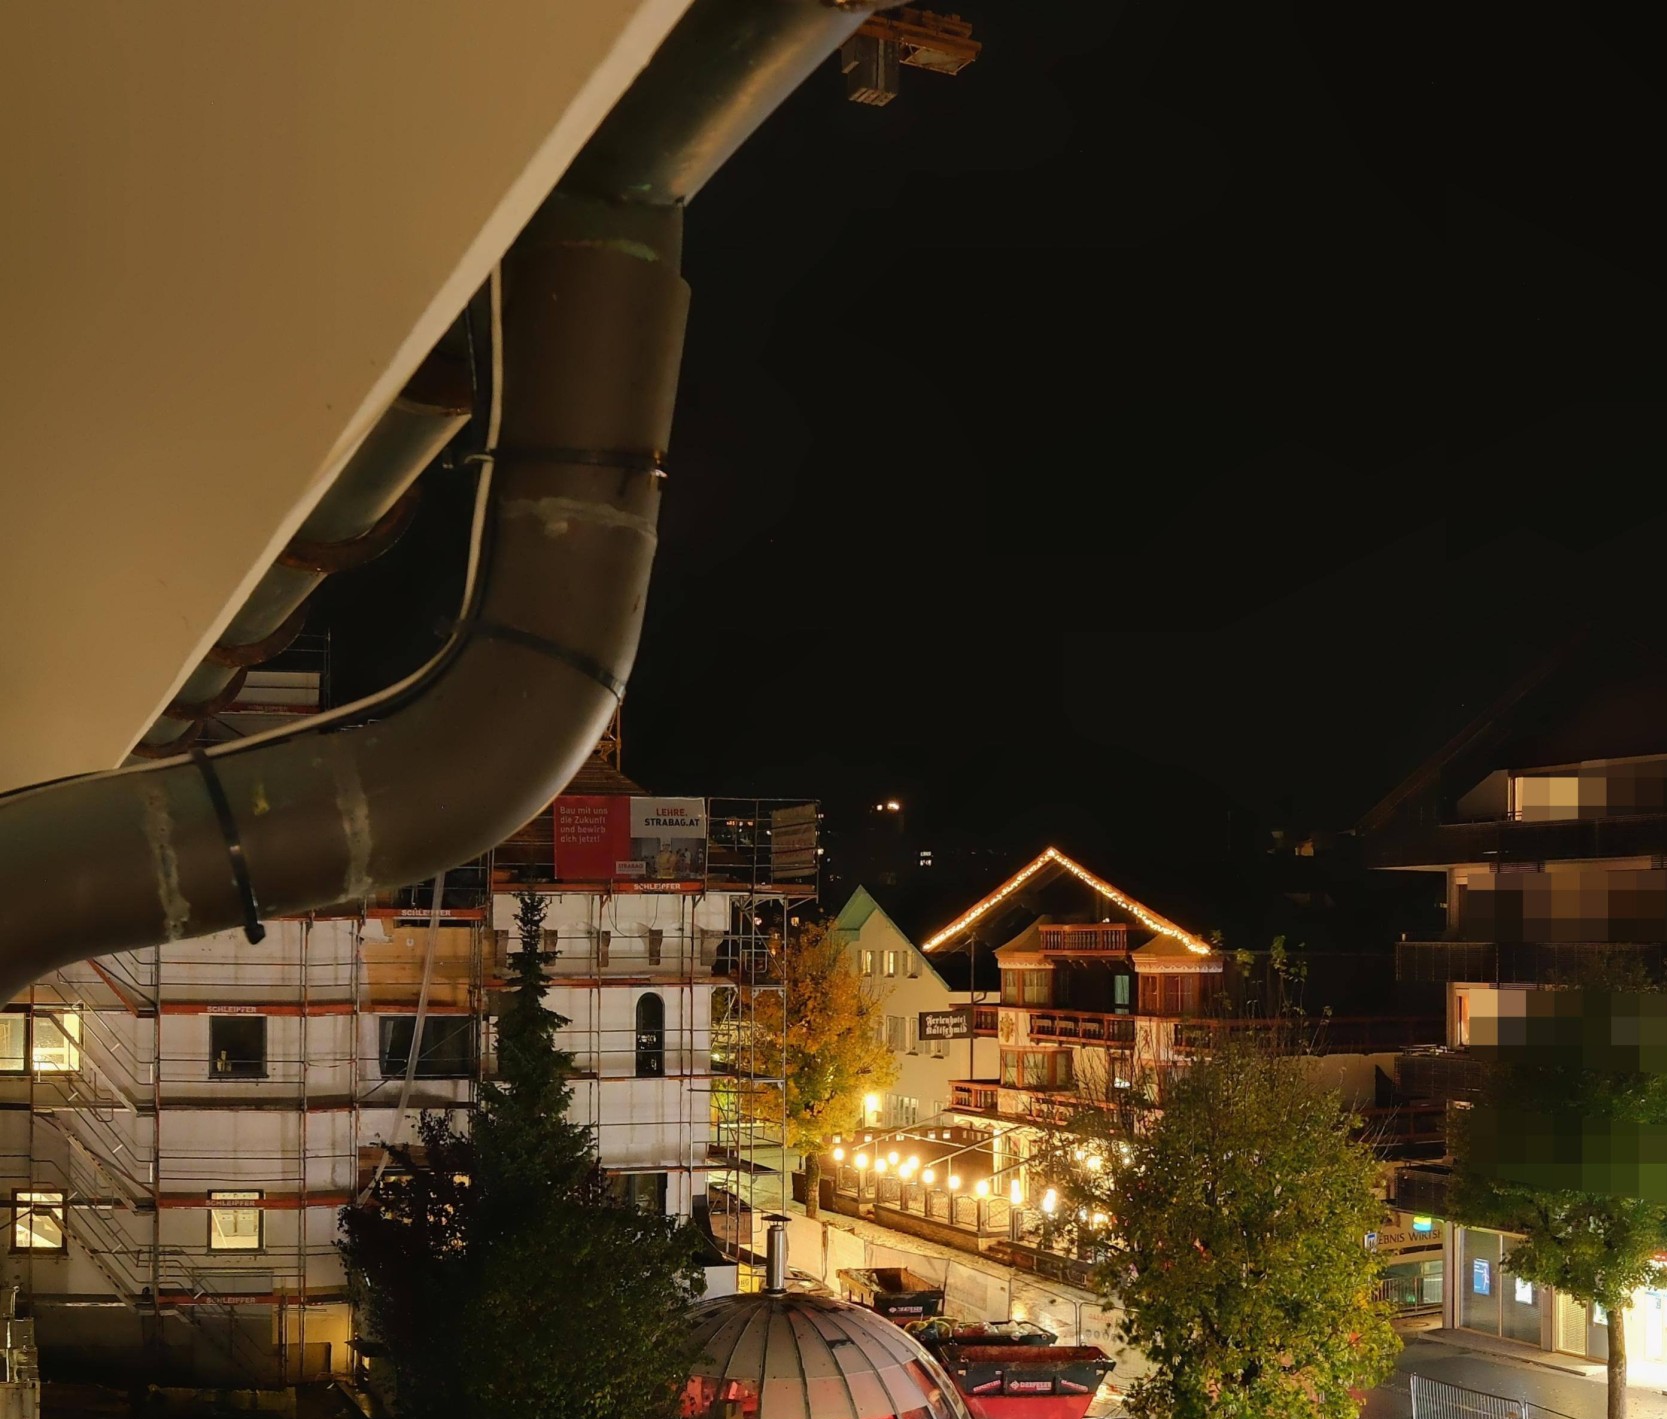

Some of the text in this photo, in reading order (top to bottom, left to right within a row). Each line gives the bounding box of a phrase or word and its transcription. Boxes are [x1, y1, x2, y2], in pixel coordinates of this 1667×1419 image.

[560, 806, 575, 815] Bau
[577, 806, 591, 815] mit
[656, 808, 688, 817] LEHRE.
[560, 816, 606, 825] die Zukunft
[644, 818, 700, 827] STRABAG.AT
[560, 826, 575, 834] und
[560, 835, 576, 843] dich
[633, 882, 681, 891] SCHLEIPFER
[206, 1006, 257, 1014] SCHLEIPFER
